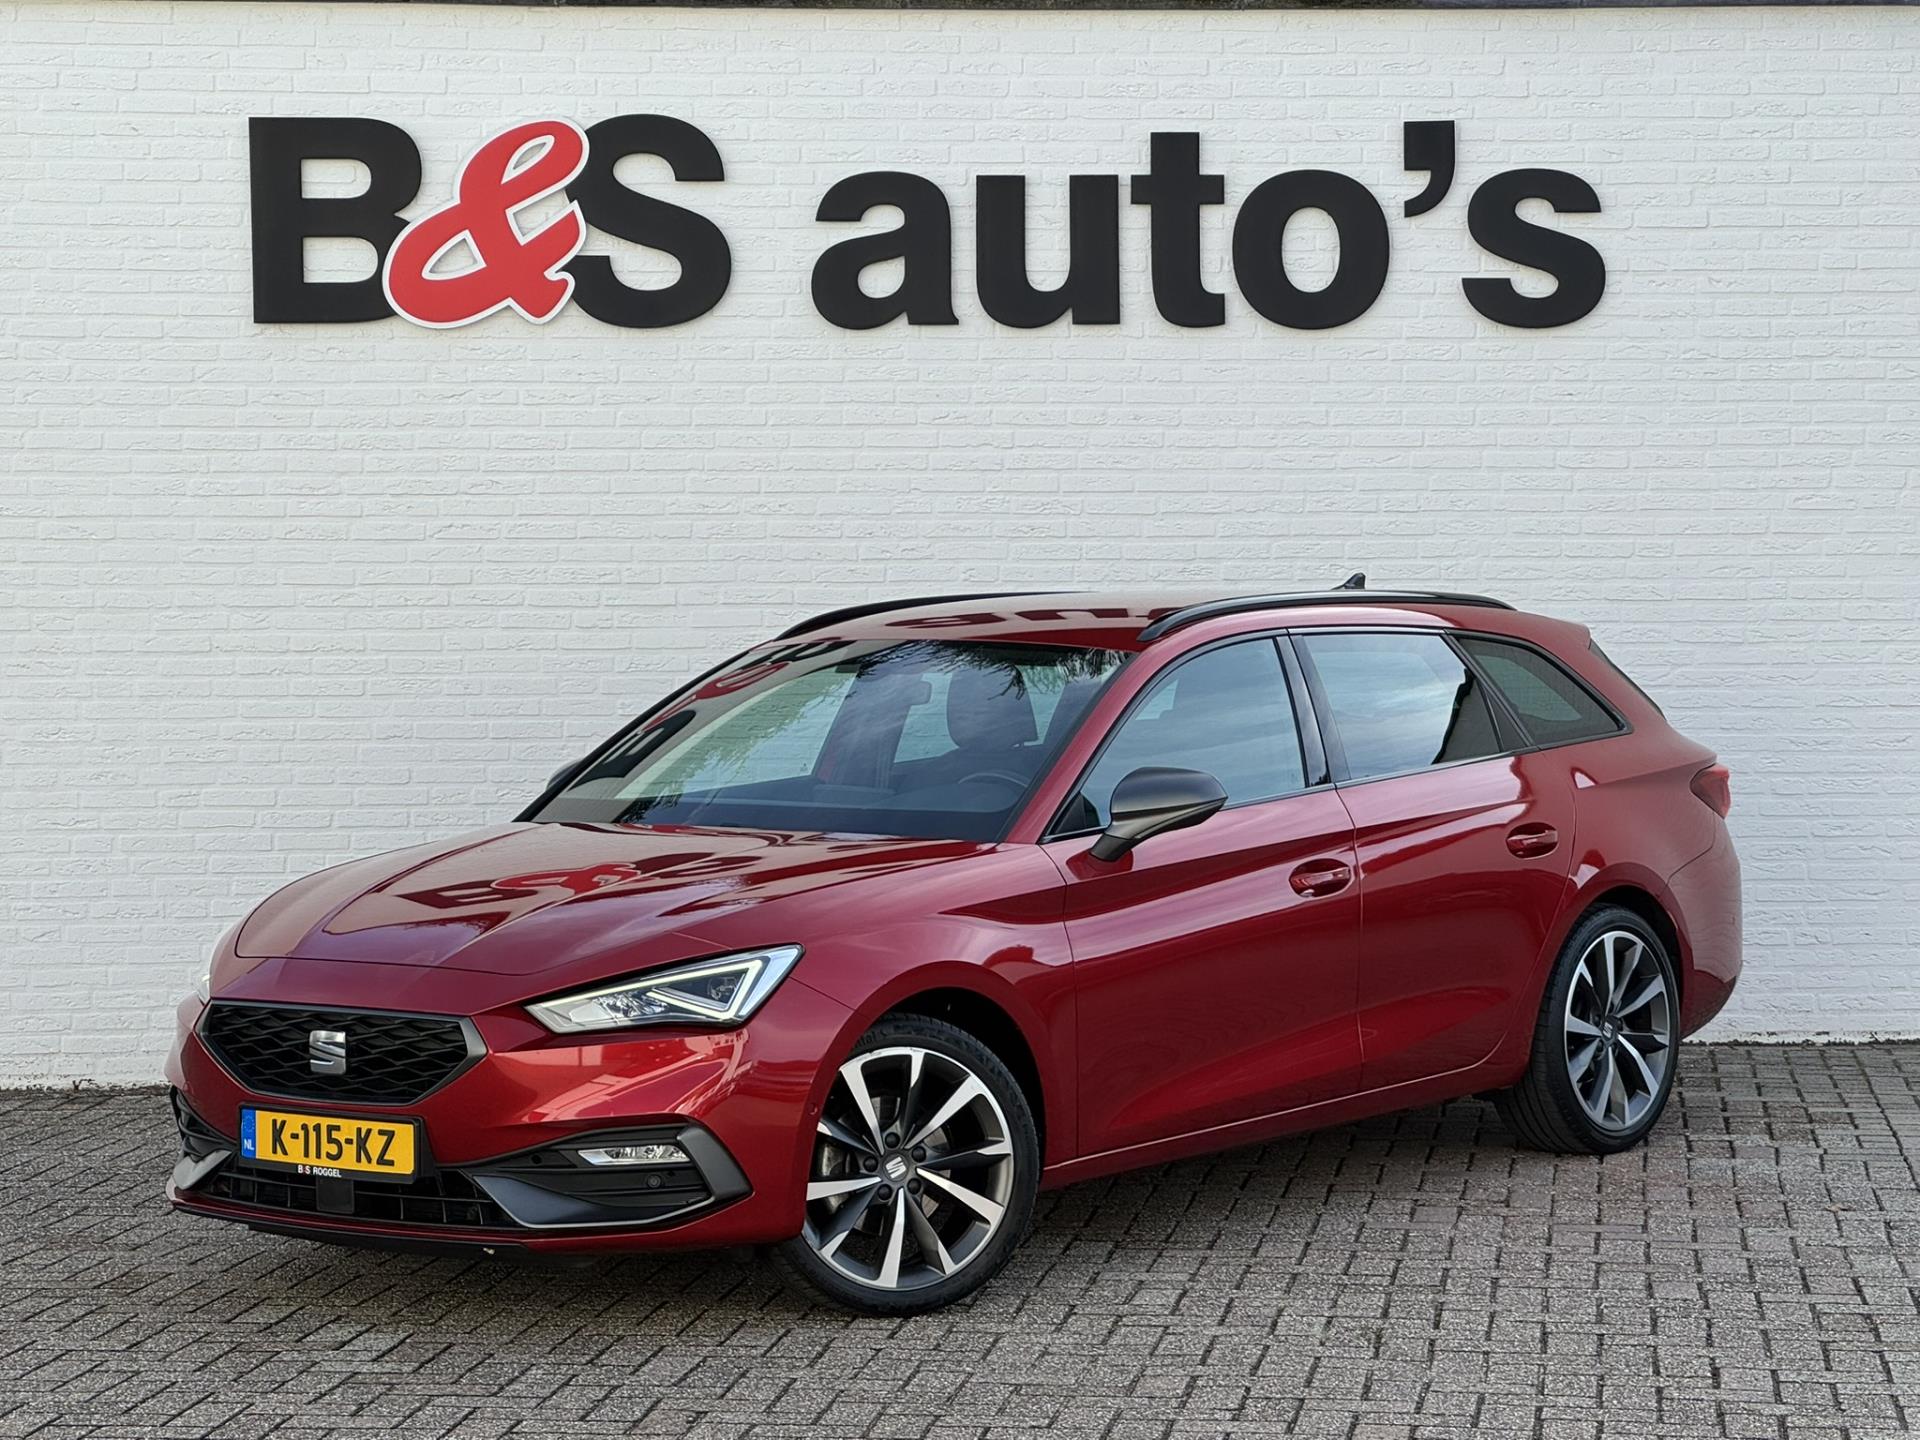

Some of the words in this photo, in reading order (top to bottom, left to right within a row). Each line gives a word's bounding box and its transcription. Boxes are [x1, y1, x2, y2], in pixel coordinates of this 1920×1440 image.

[248, 113, 732, 330] B&S
[811, 120, 1606, 331] auto’s
[243, 1138, 255, 1151] NL
[271, 1118, 396, 1167] K-115-KZ
[312, 1166, 342, 1178] ROGGEL
